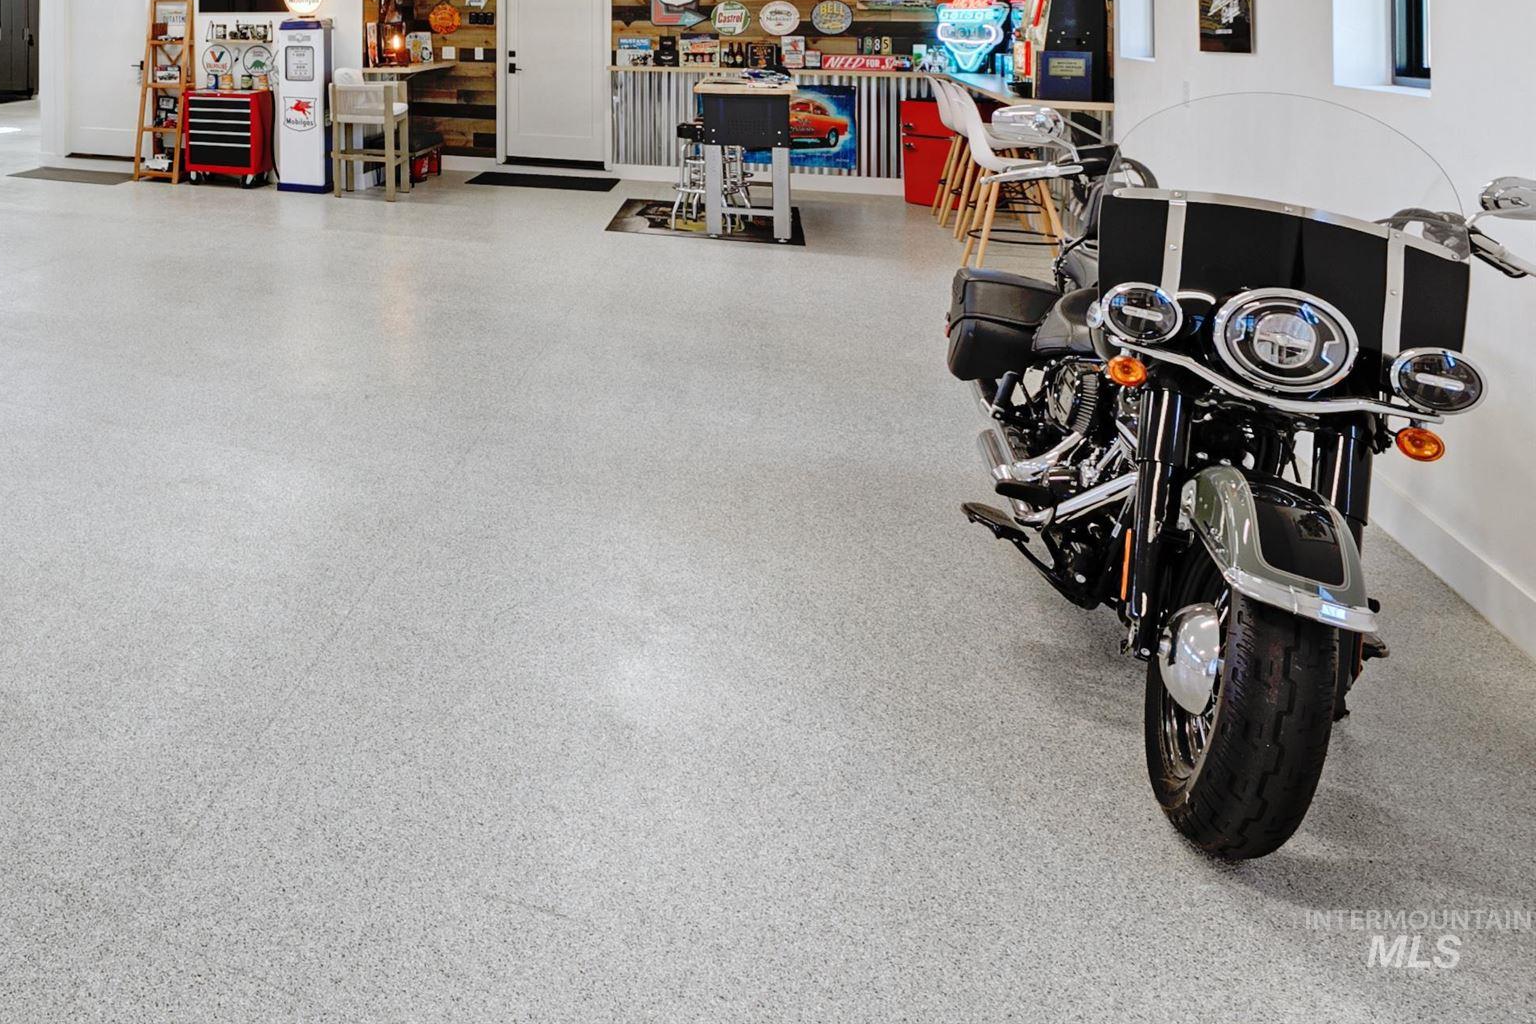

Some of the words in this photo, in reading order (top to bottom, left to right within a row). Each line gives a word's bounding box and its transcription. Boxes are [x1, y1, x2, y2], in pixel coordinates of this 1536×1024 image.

[820, 2, 844, 15] BELL
[717, 11, 743, 23] Castrol
[824, 57, 864, 68] NEED
[866, 59, 880, 68] FOR
[286, 117, 314, 127] Mobilgas
